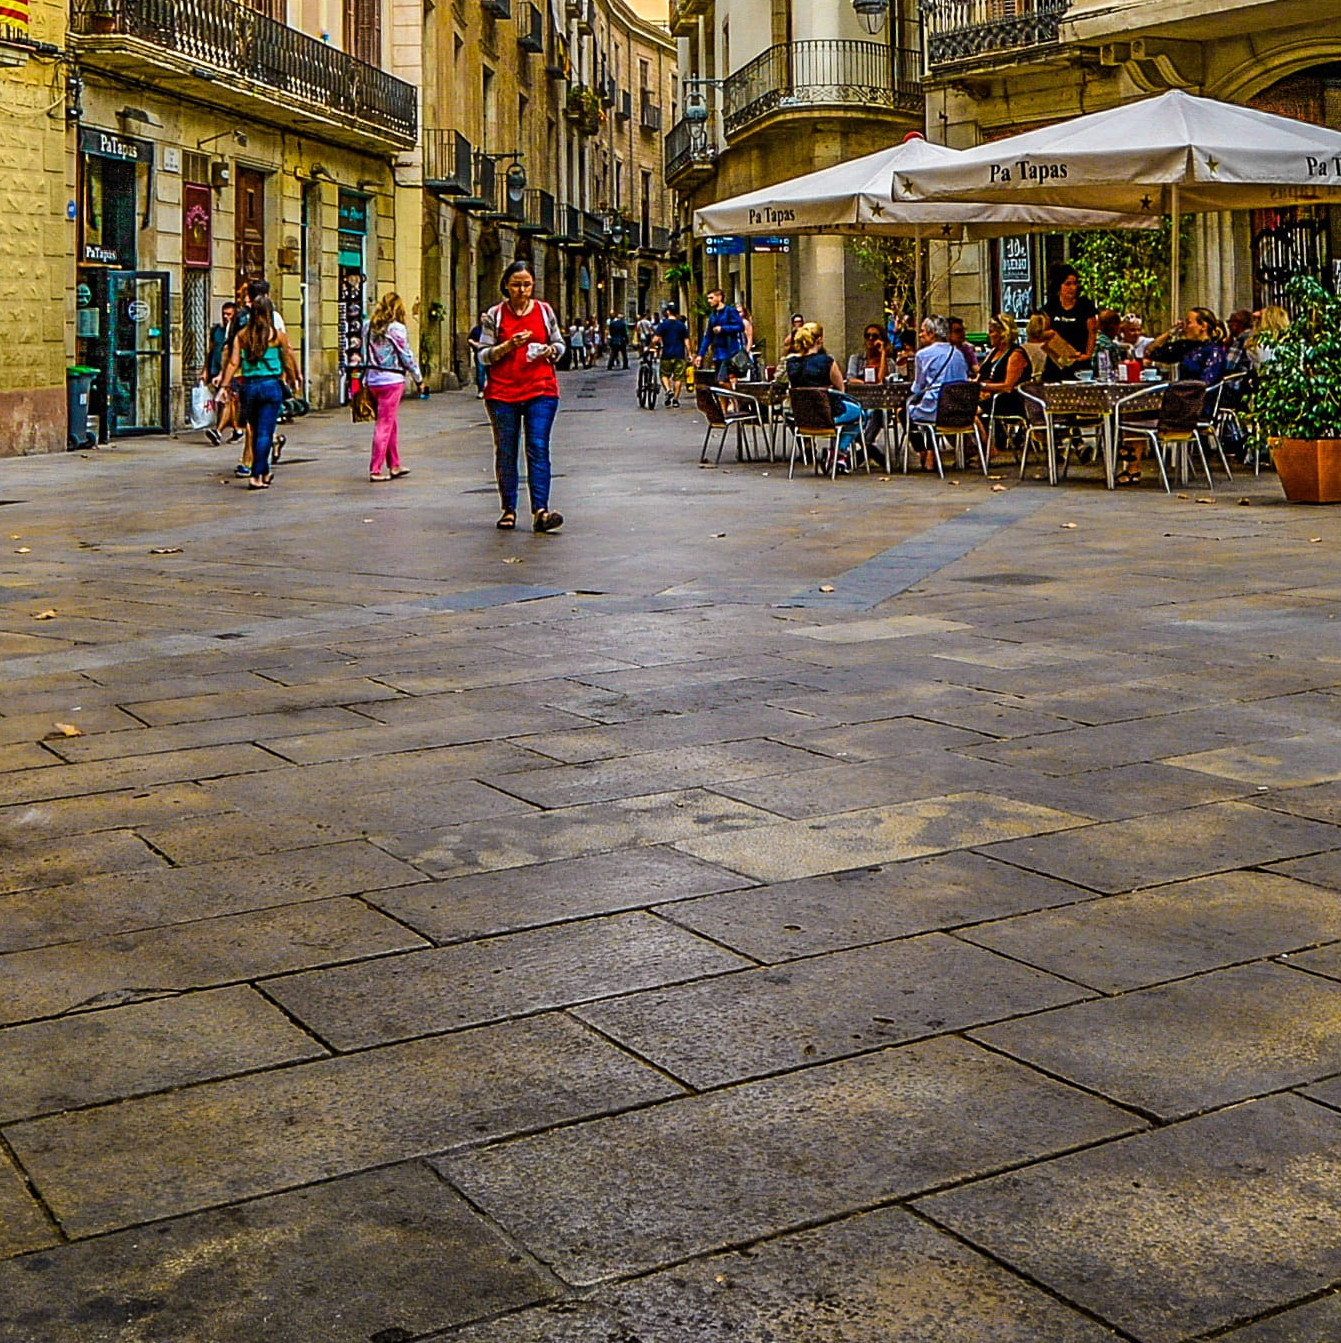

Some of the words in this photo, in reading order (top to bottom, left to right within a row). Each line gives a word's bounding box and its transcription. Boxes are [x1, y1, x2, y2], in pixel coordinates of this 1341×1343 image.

[990, 164, 1011, 183] Pa
[1016, 160, 1068, 185] Tapas
[1306, 156, 1327, 176] Pa
[749, 208, 762, 224] Pa
[764, 206, 796, 227] Tapas
